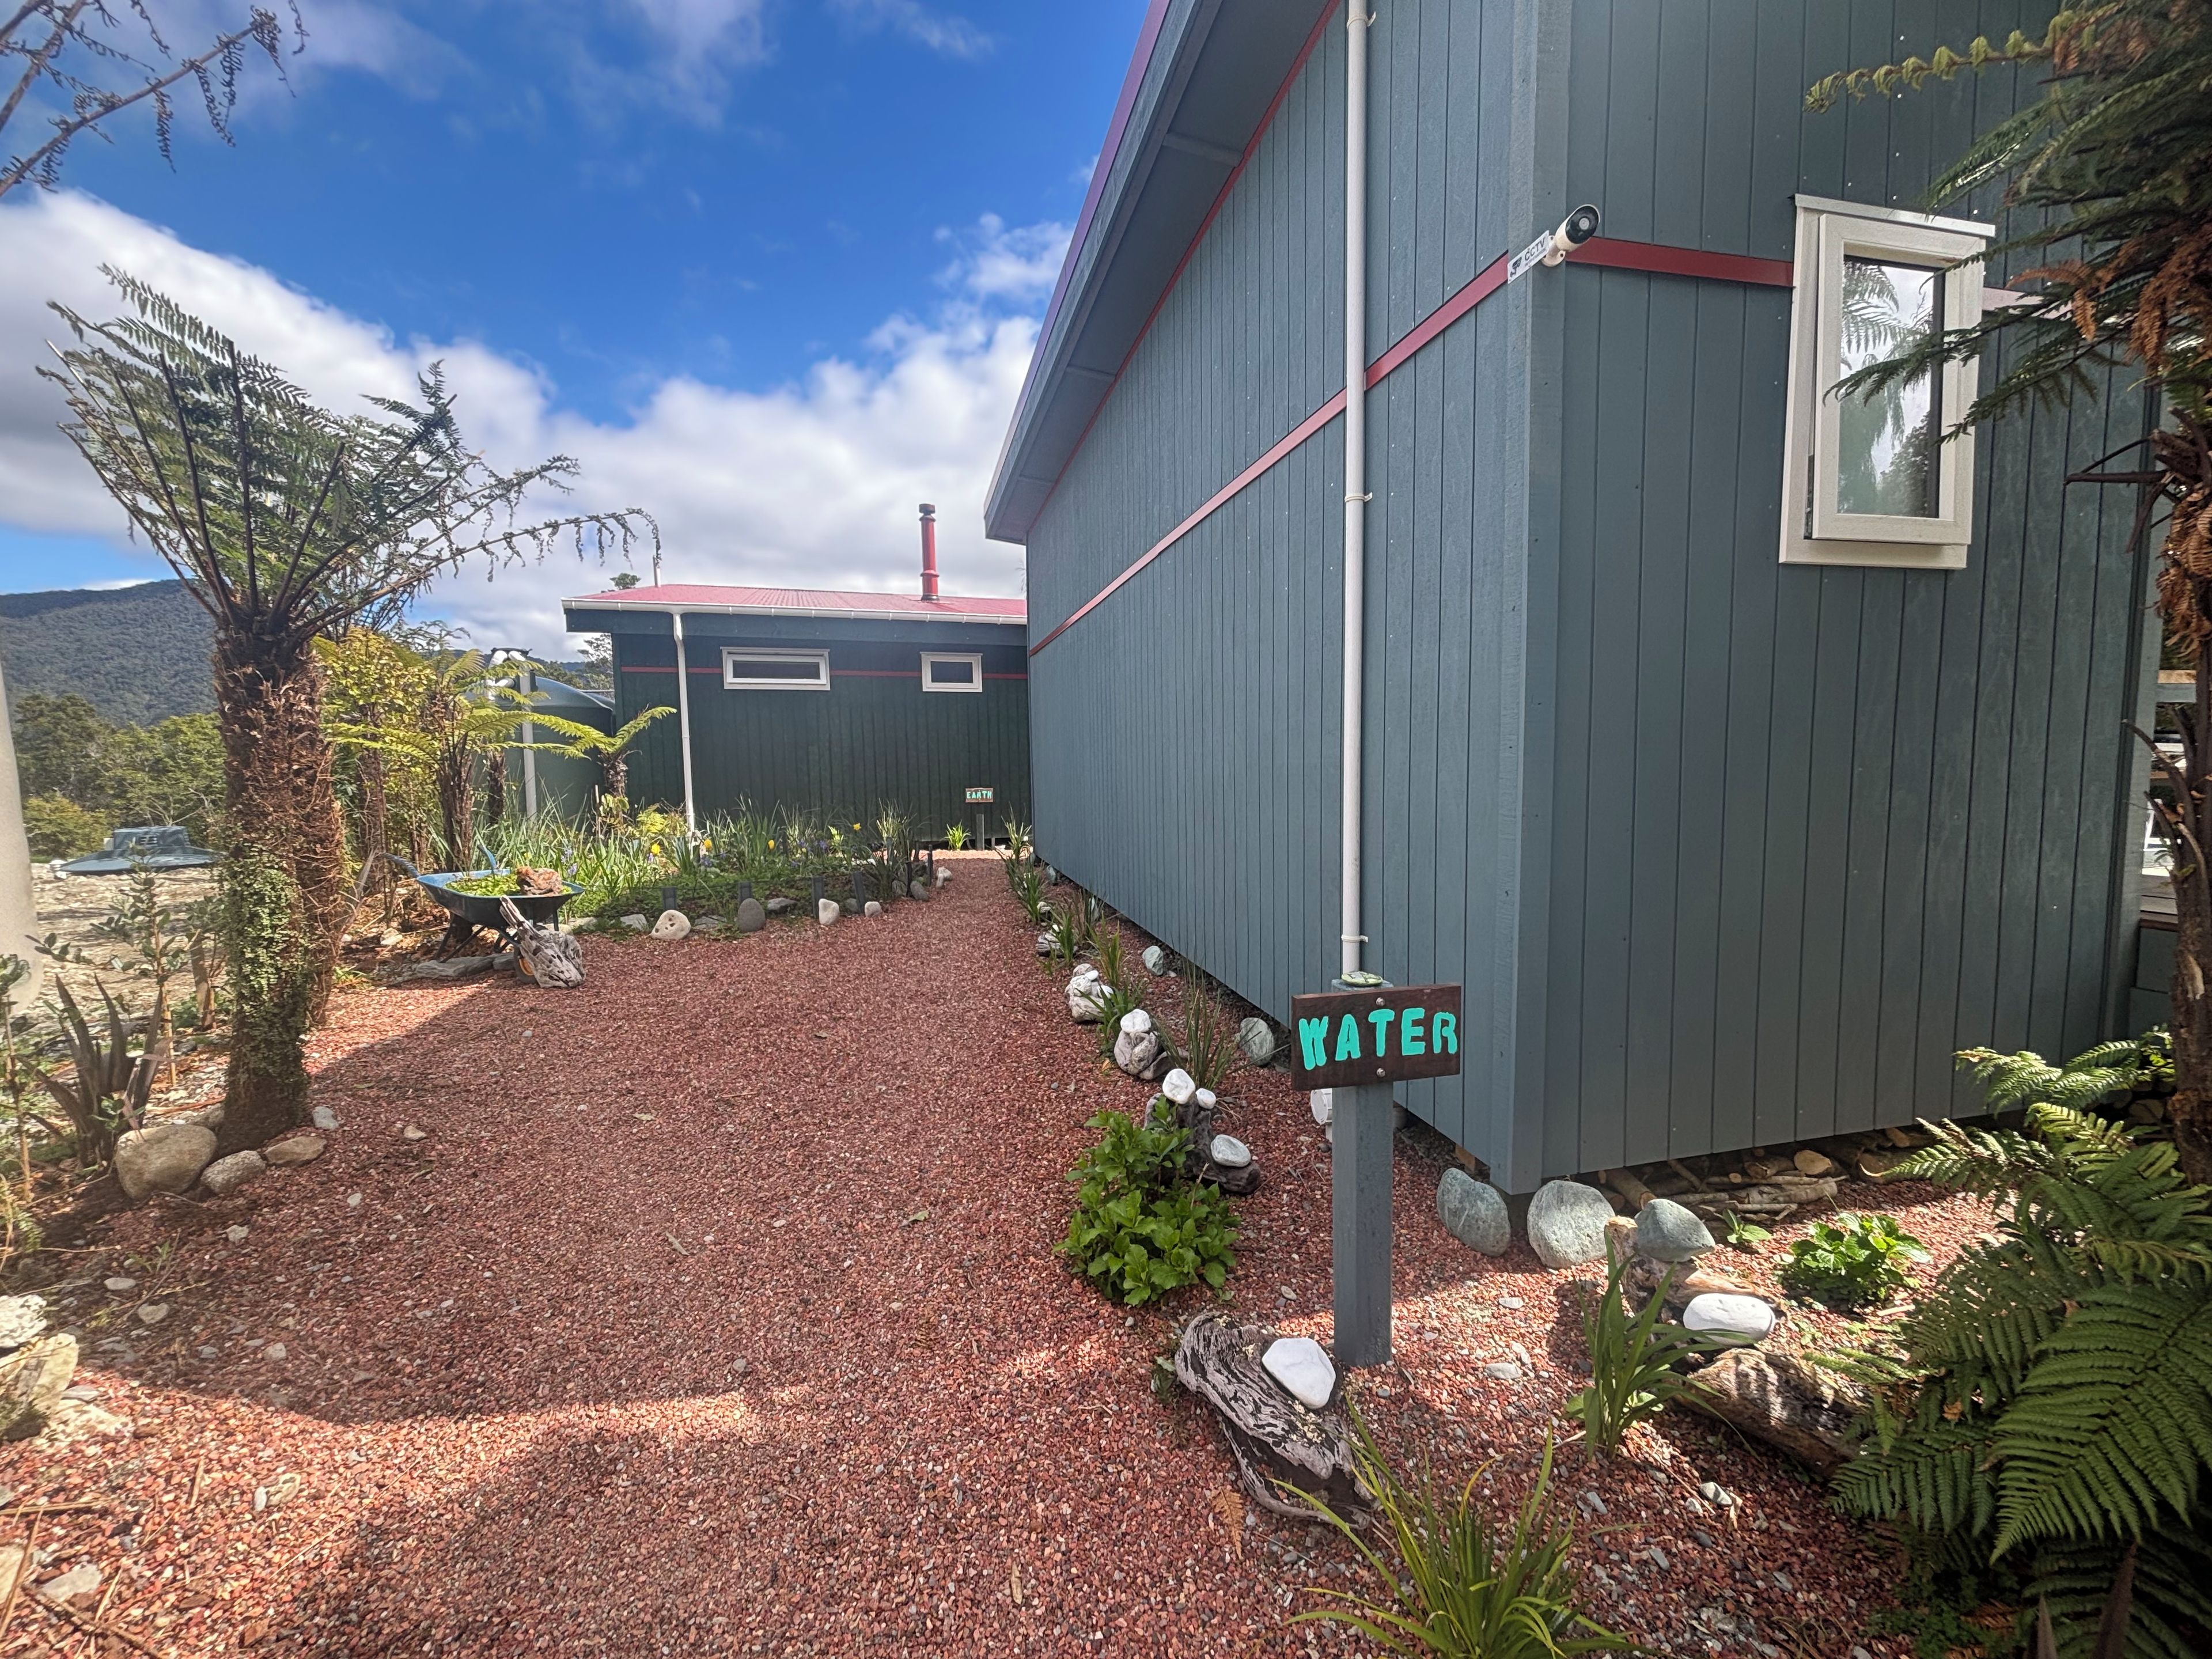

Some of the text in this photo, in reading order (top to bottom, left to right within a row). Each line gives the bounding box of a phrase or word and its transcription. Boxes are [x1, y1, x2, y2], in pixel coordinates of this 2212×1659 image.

[1525, 237, 1546, 261] CCTV
[967, 791, 991, 799] EARTH
[1298, 1007, 1457, 1070] WATER
